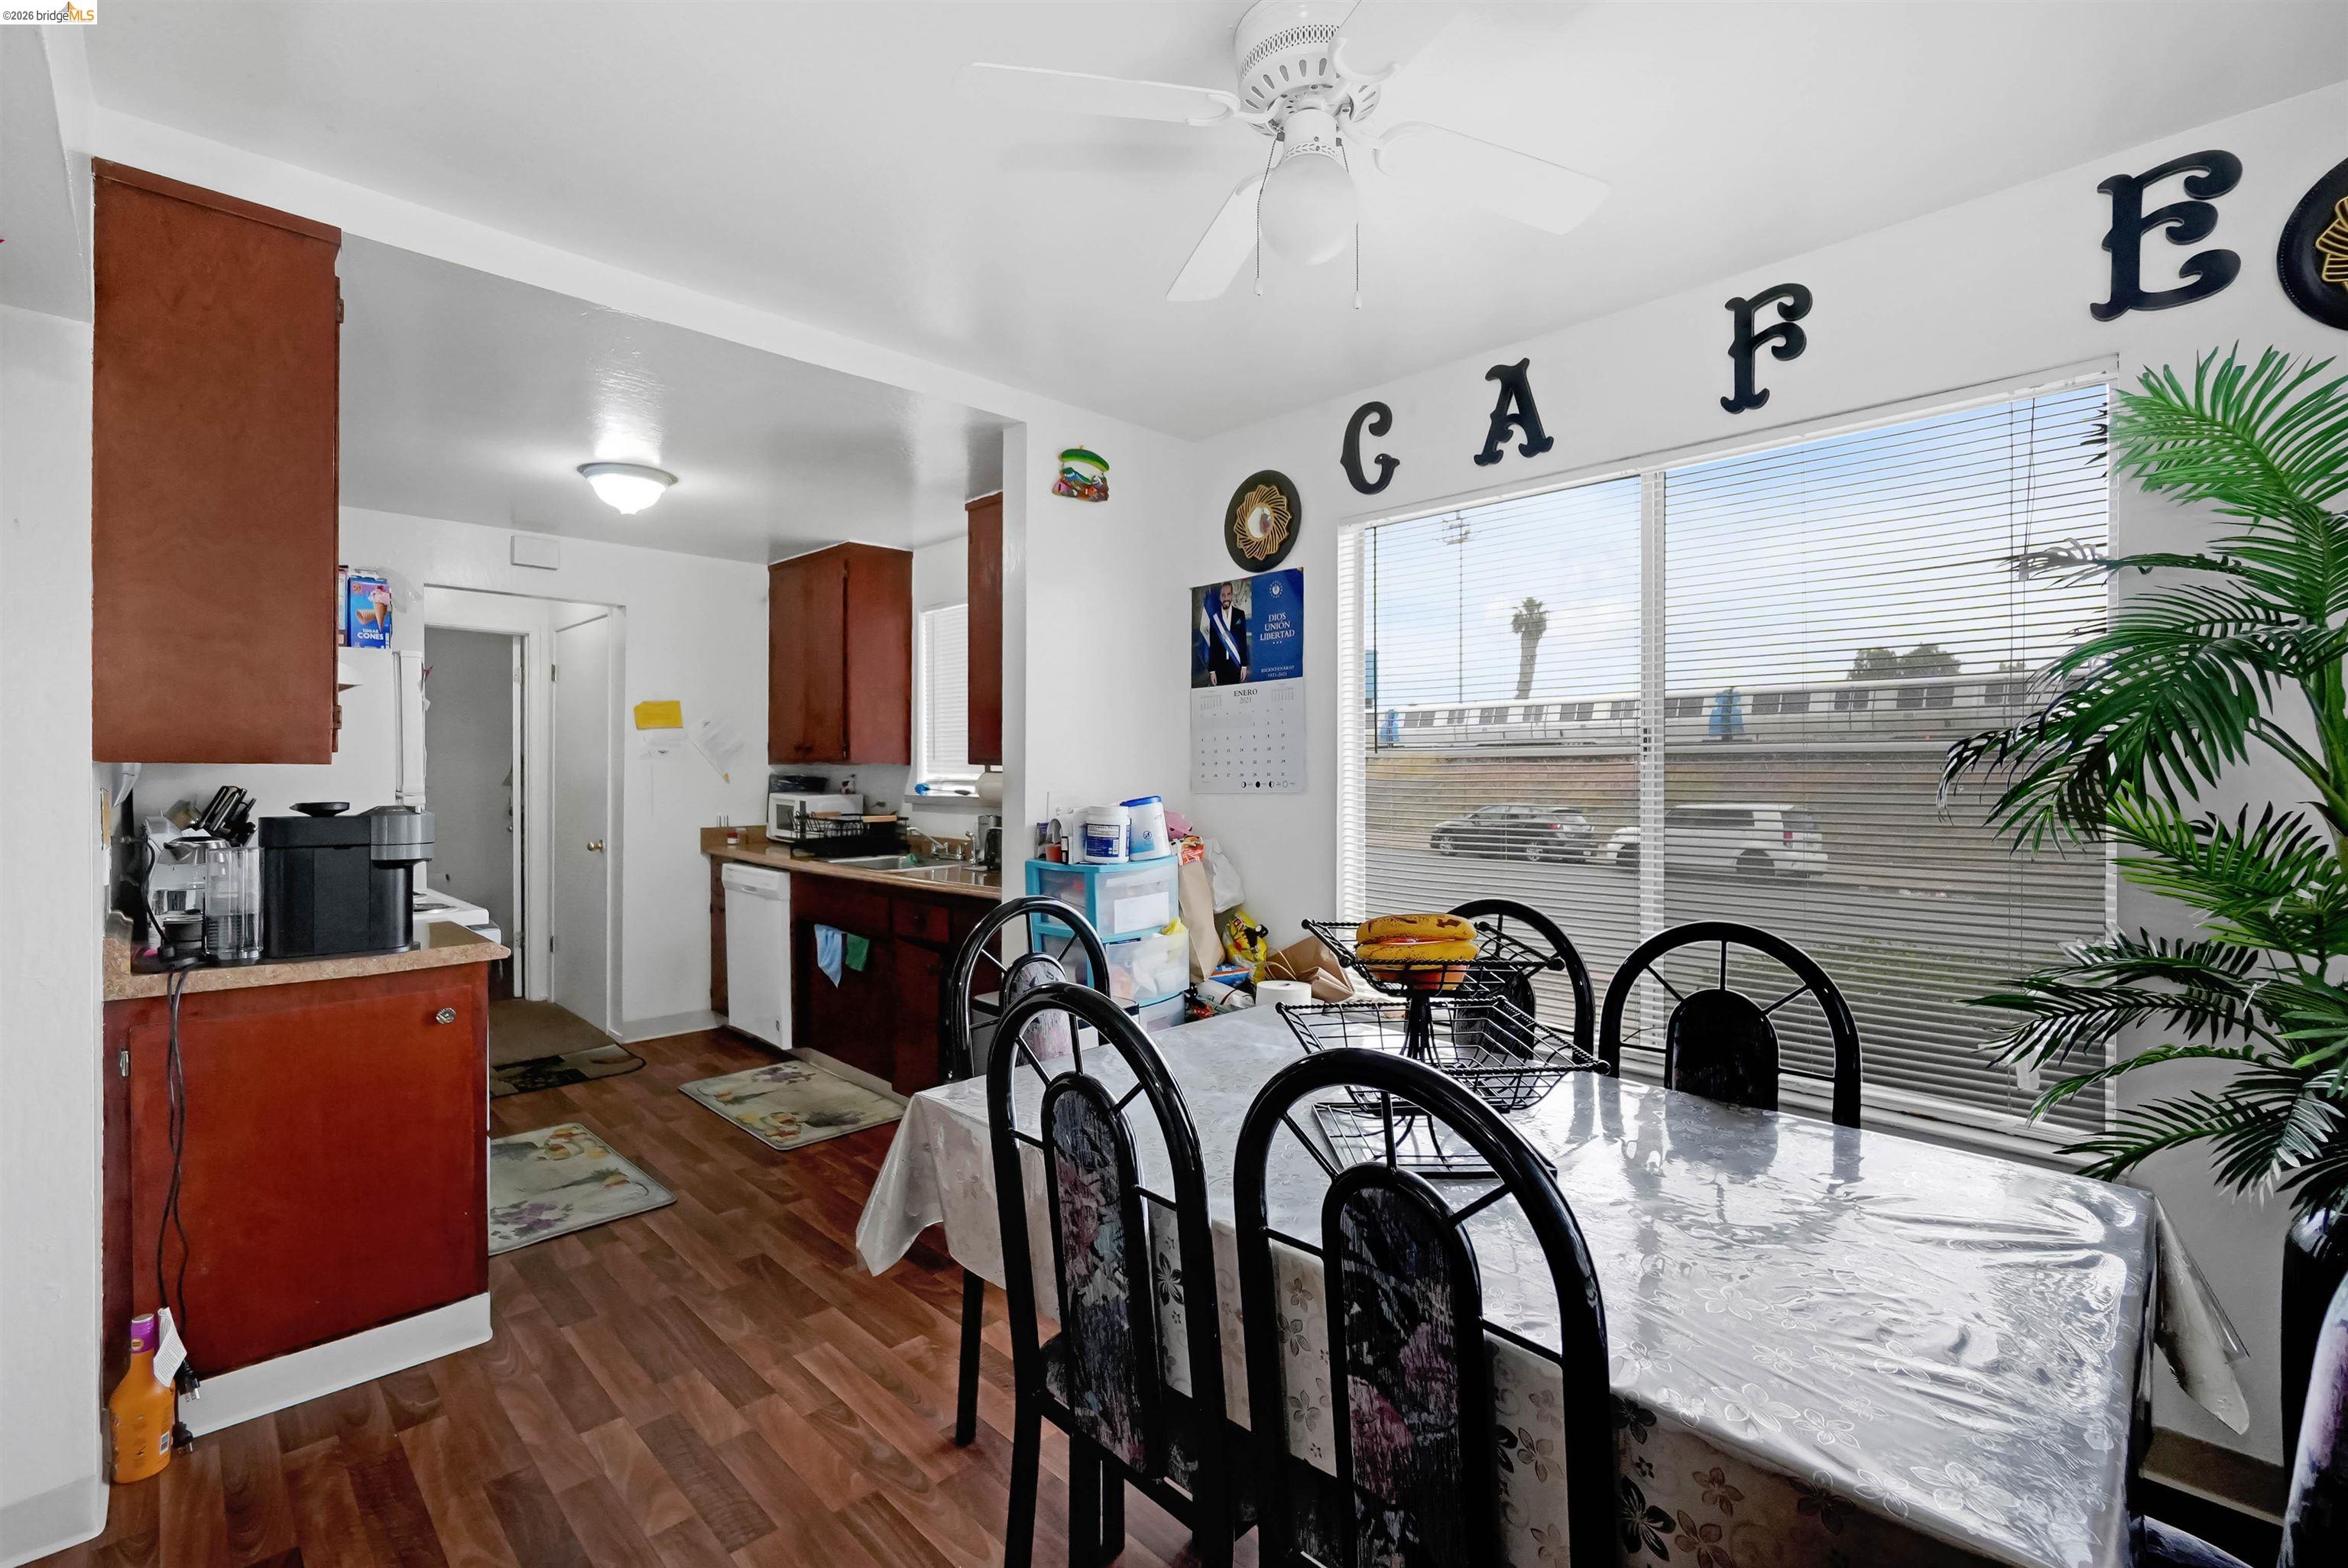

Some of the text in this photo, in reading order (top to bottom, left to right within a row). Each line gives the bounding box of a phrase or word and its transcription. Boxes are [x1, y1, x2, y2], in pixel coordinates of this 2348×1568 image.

[1268, 612, 1286, 623] DIOS
[1264, 620, 1290, 631] UNIÓN
[357, 632, 384, 640] CONES
[1260, 629, 1296, 641] LIBERTAD
[1234, 688, 1258, 697] ENERO
